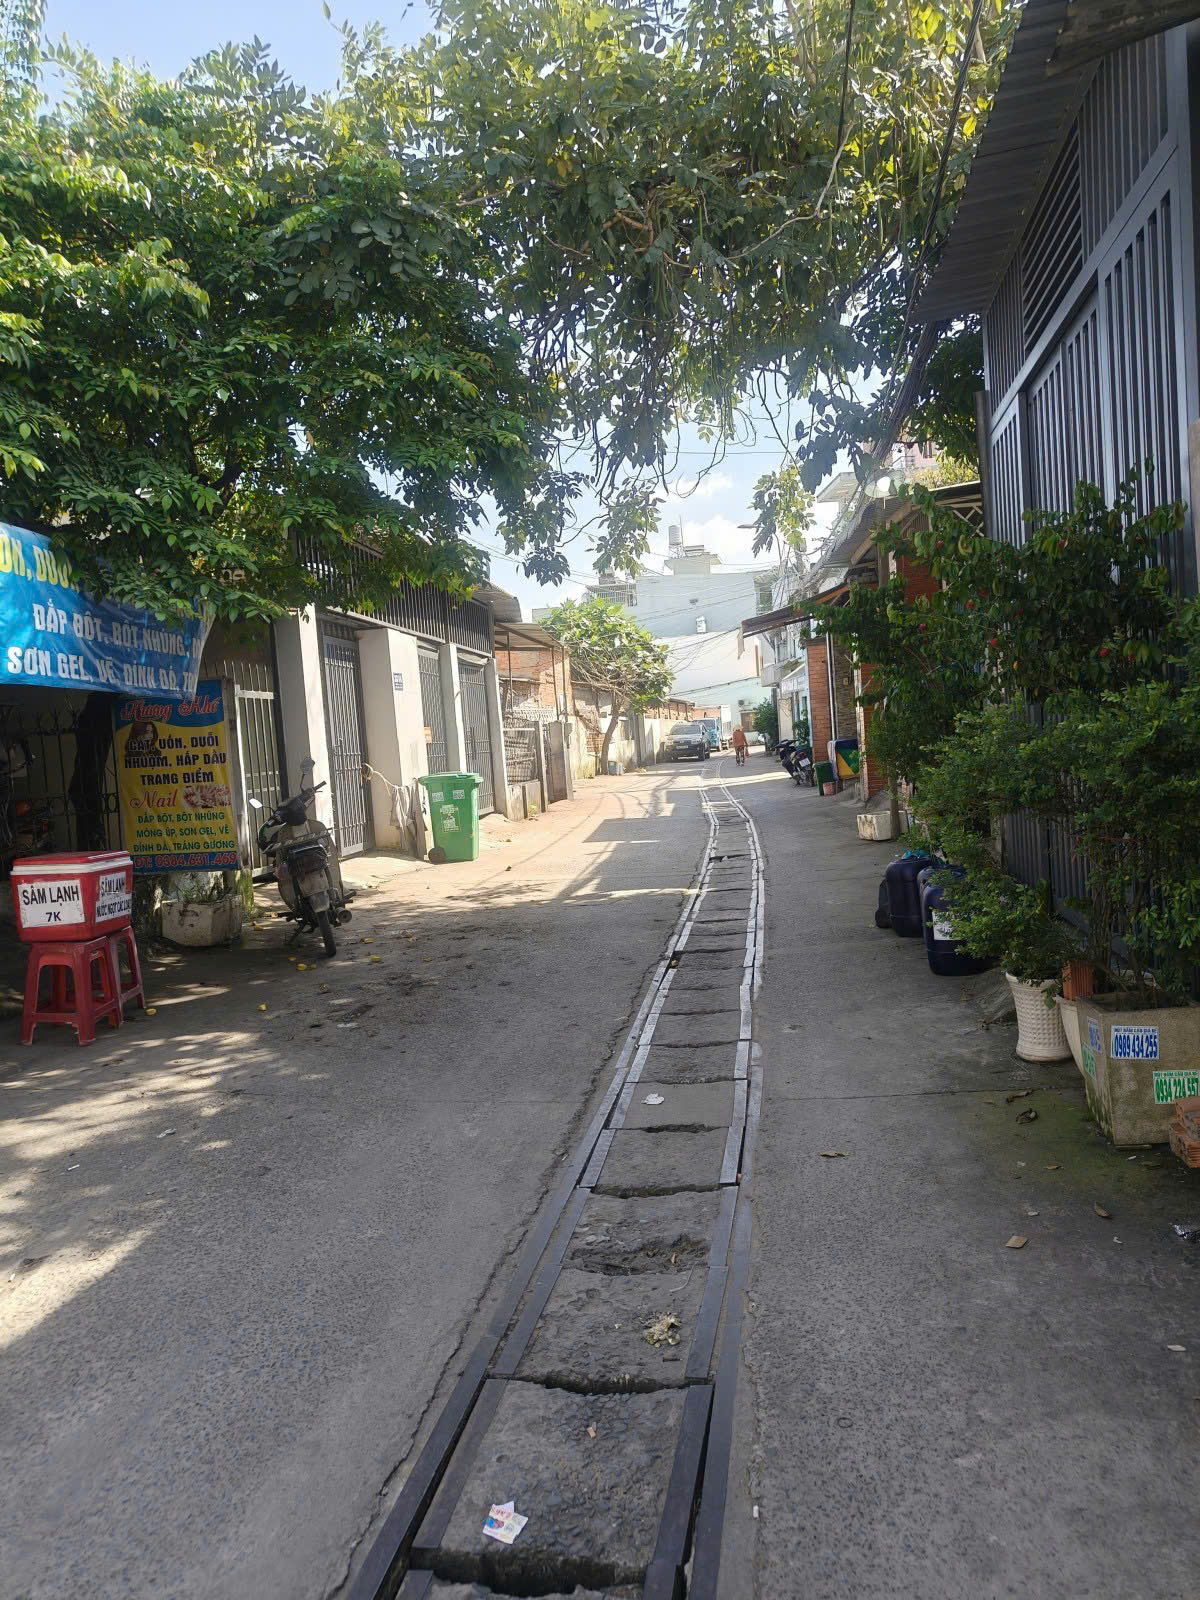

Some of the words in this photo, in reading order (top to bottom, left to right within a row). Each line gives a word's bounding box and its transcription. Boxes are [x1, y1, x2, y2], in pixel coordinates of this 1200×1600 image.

[7, 646, 51, 676] SƠN
[190, 731, 219, 748] DUỖI
[176, 751, 200, 767] HẤP
[203, 750, 227, 765] DẦU
[140, 773, 179, 786] TRANG
[182, 768, 214, 784] ĐIỂM
[130, 788, 178, 809] Nail
[176, 811, 193, 824] BỘT
[195, 811, 225, 822] NHÚNG
[179, 827, 197, 836] SƠN
[172, 840, 201, 851] TRÁNG
[203, 839, 235, 849] GƯƠNG
[22, 885, 47, 906] SÂM
[49, 885, 80, 906] LẠNH
[45, 911, 62, 922] 7K
